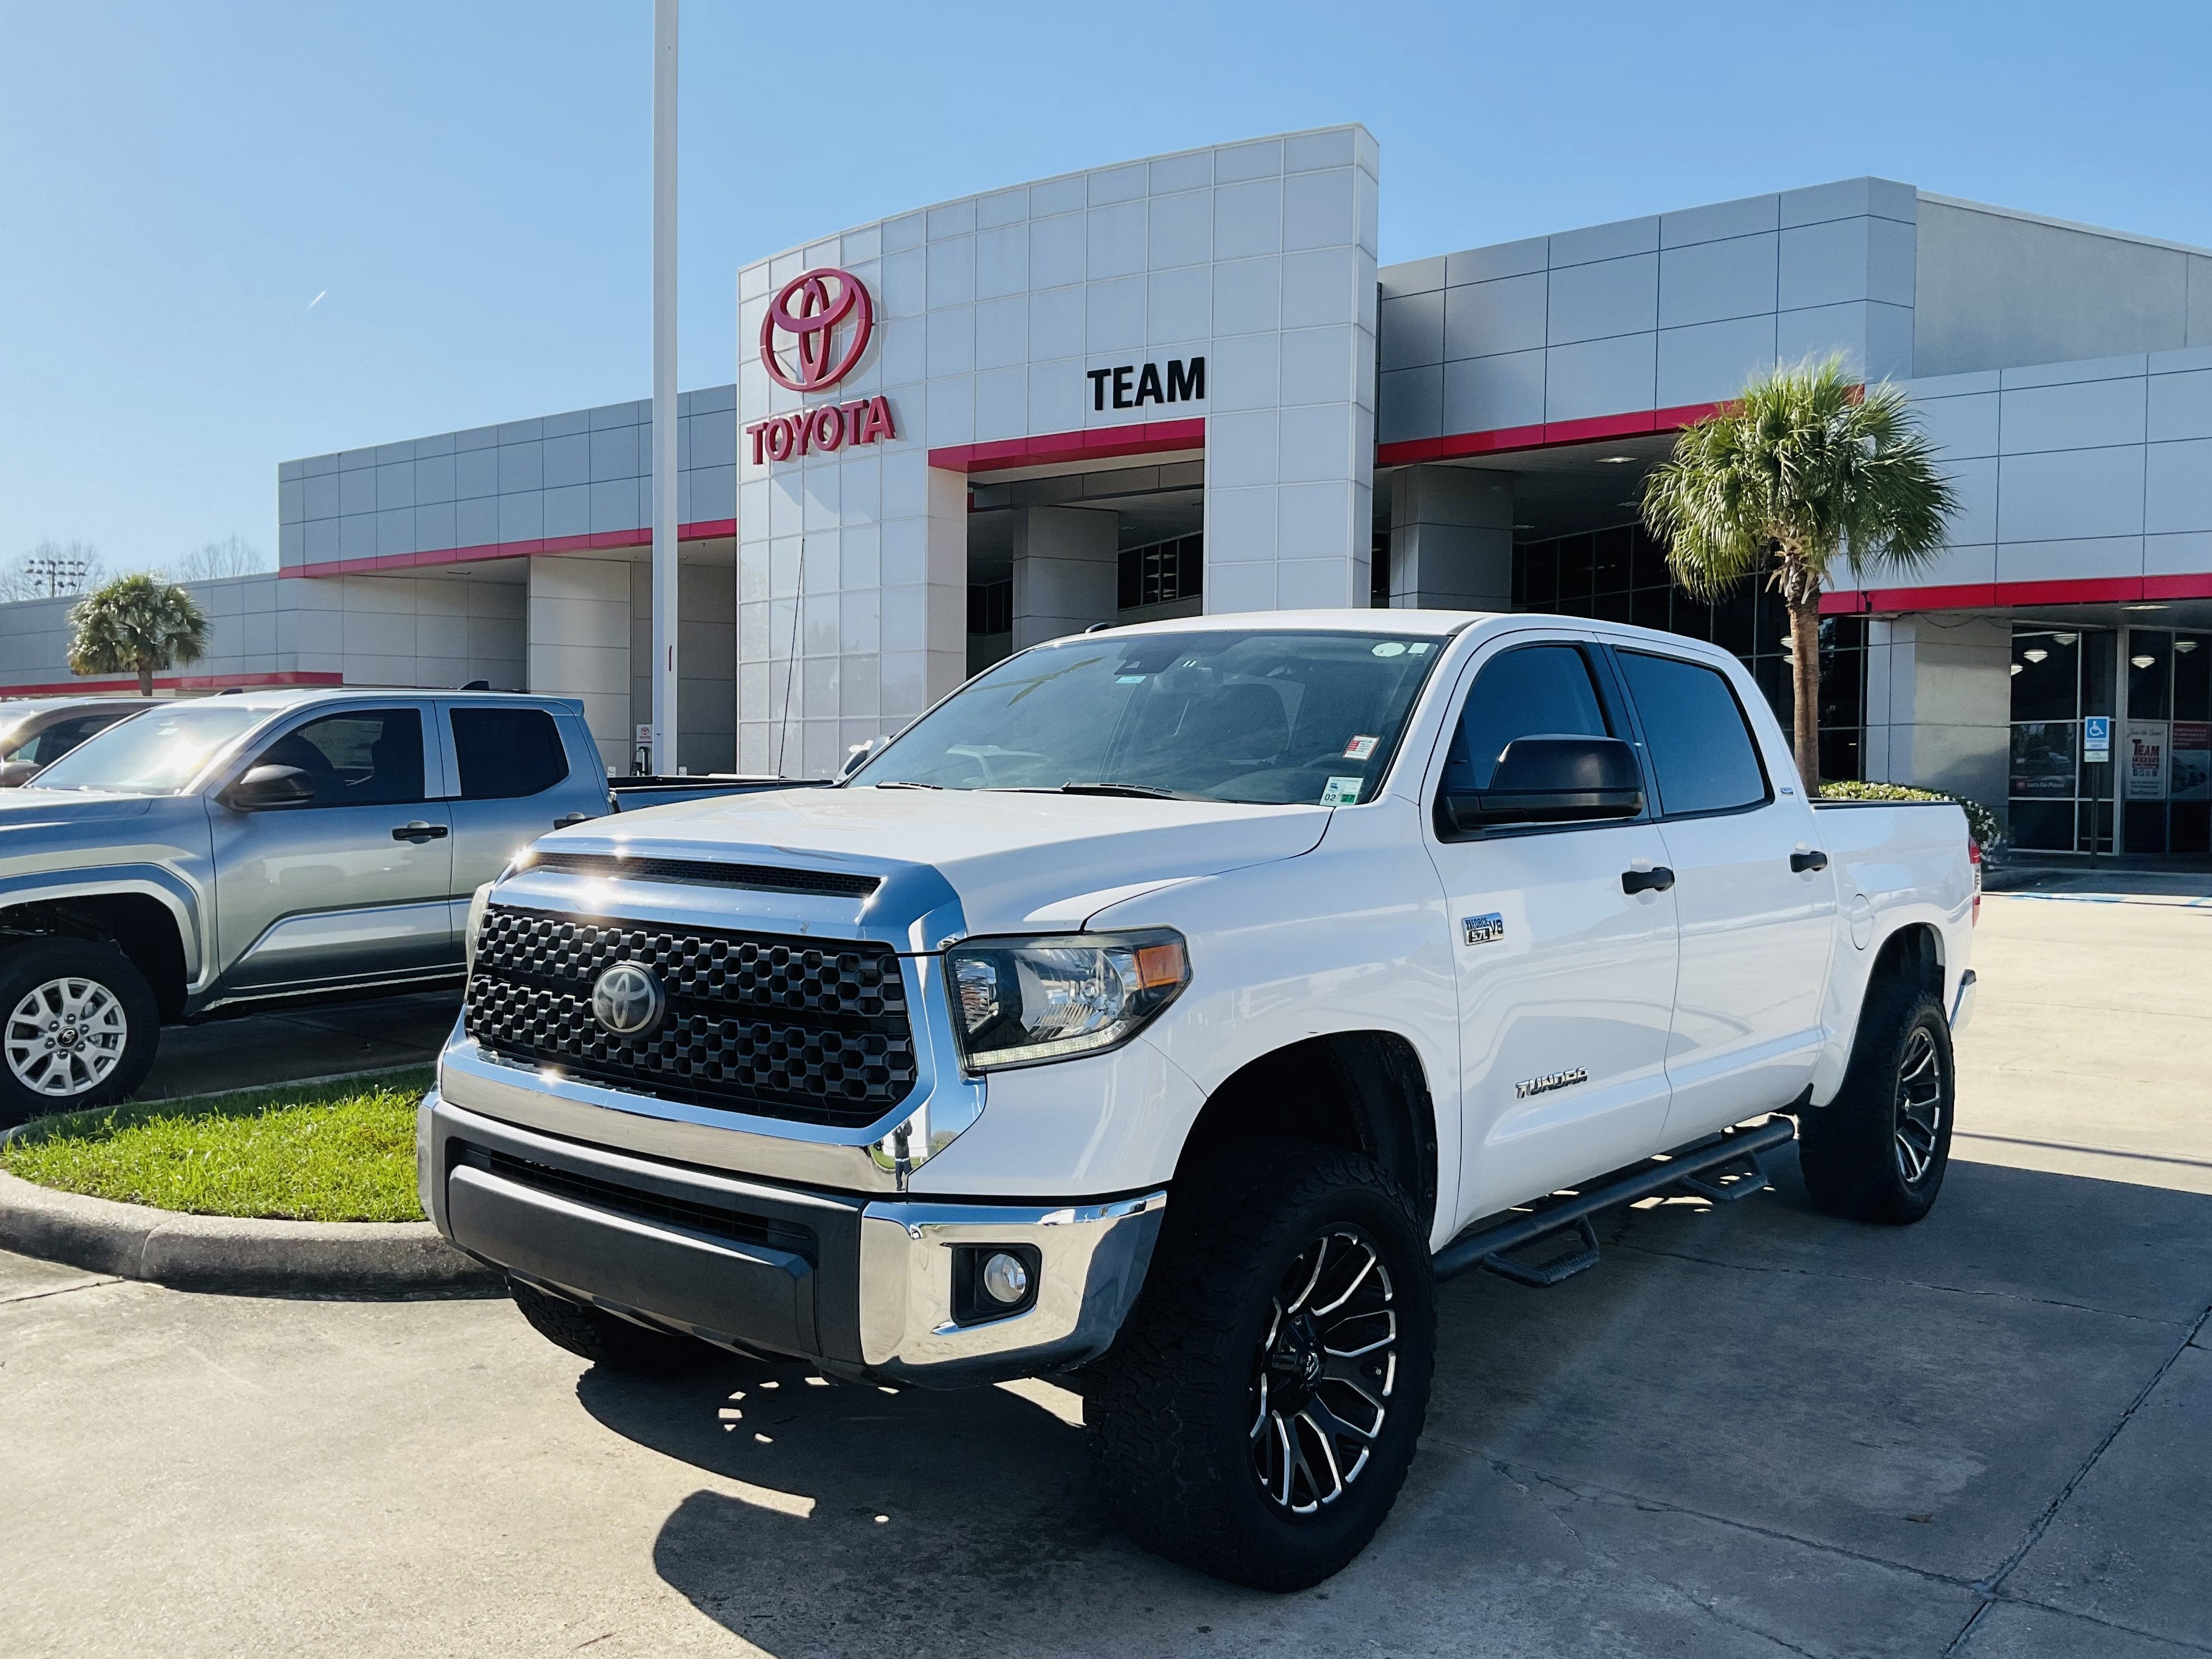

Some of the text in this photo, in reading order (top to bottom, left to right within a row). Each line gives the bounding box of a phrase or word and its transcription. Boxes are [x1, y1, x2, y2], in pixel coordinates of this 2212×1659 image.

[1087, 357, 1204, 410] TEAM
[746, 395, 896, 465] TOYOTA
[1341, 794, 1356, 803] 27
[1489, 919, 1504, 935] V8
[1515, 1066, 1588, 1098] TUNDRA
